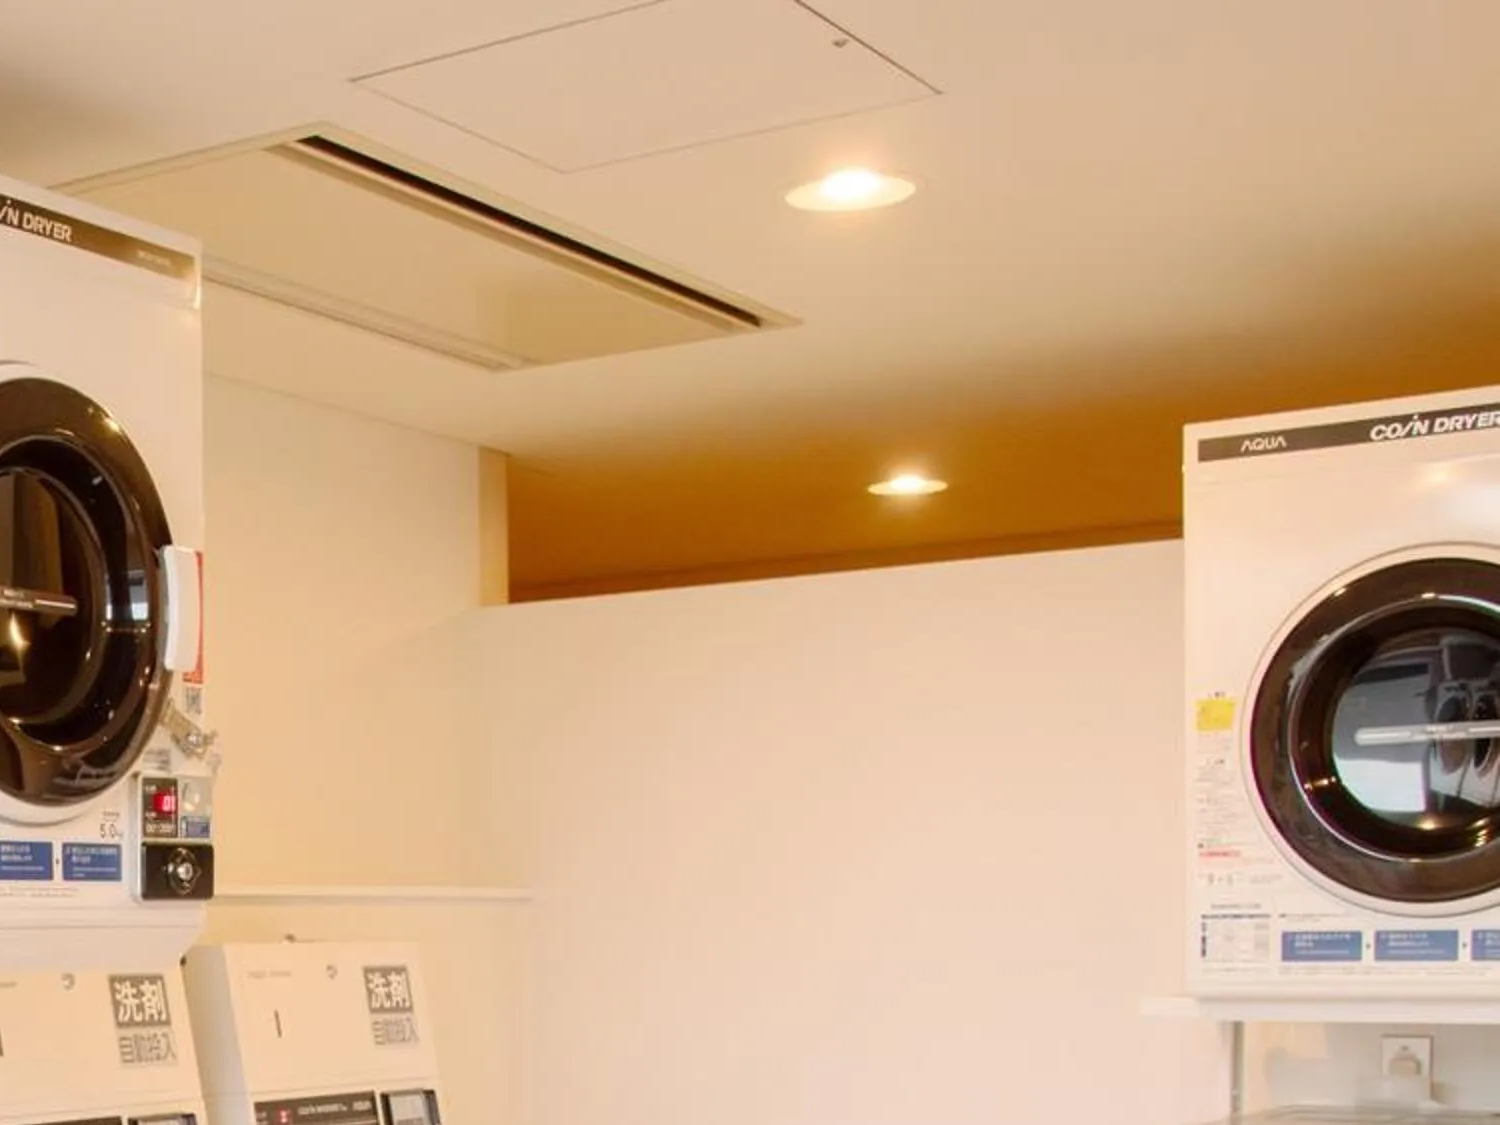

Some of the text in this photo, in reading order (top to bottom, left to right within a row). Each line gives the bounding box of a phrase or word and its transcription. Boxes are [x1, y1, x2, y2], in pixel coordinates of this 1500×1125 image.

[22, 213, 73, 243] DRYER
[1240, 435, 1287, 453] AQUA
[115, 979, 168, 1024] 洗剤
